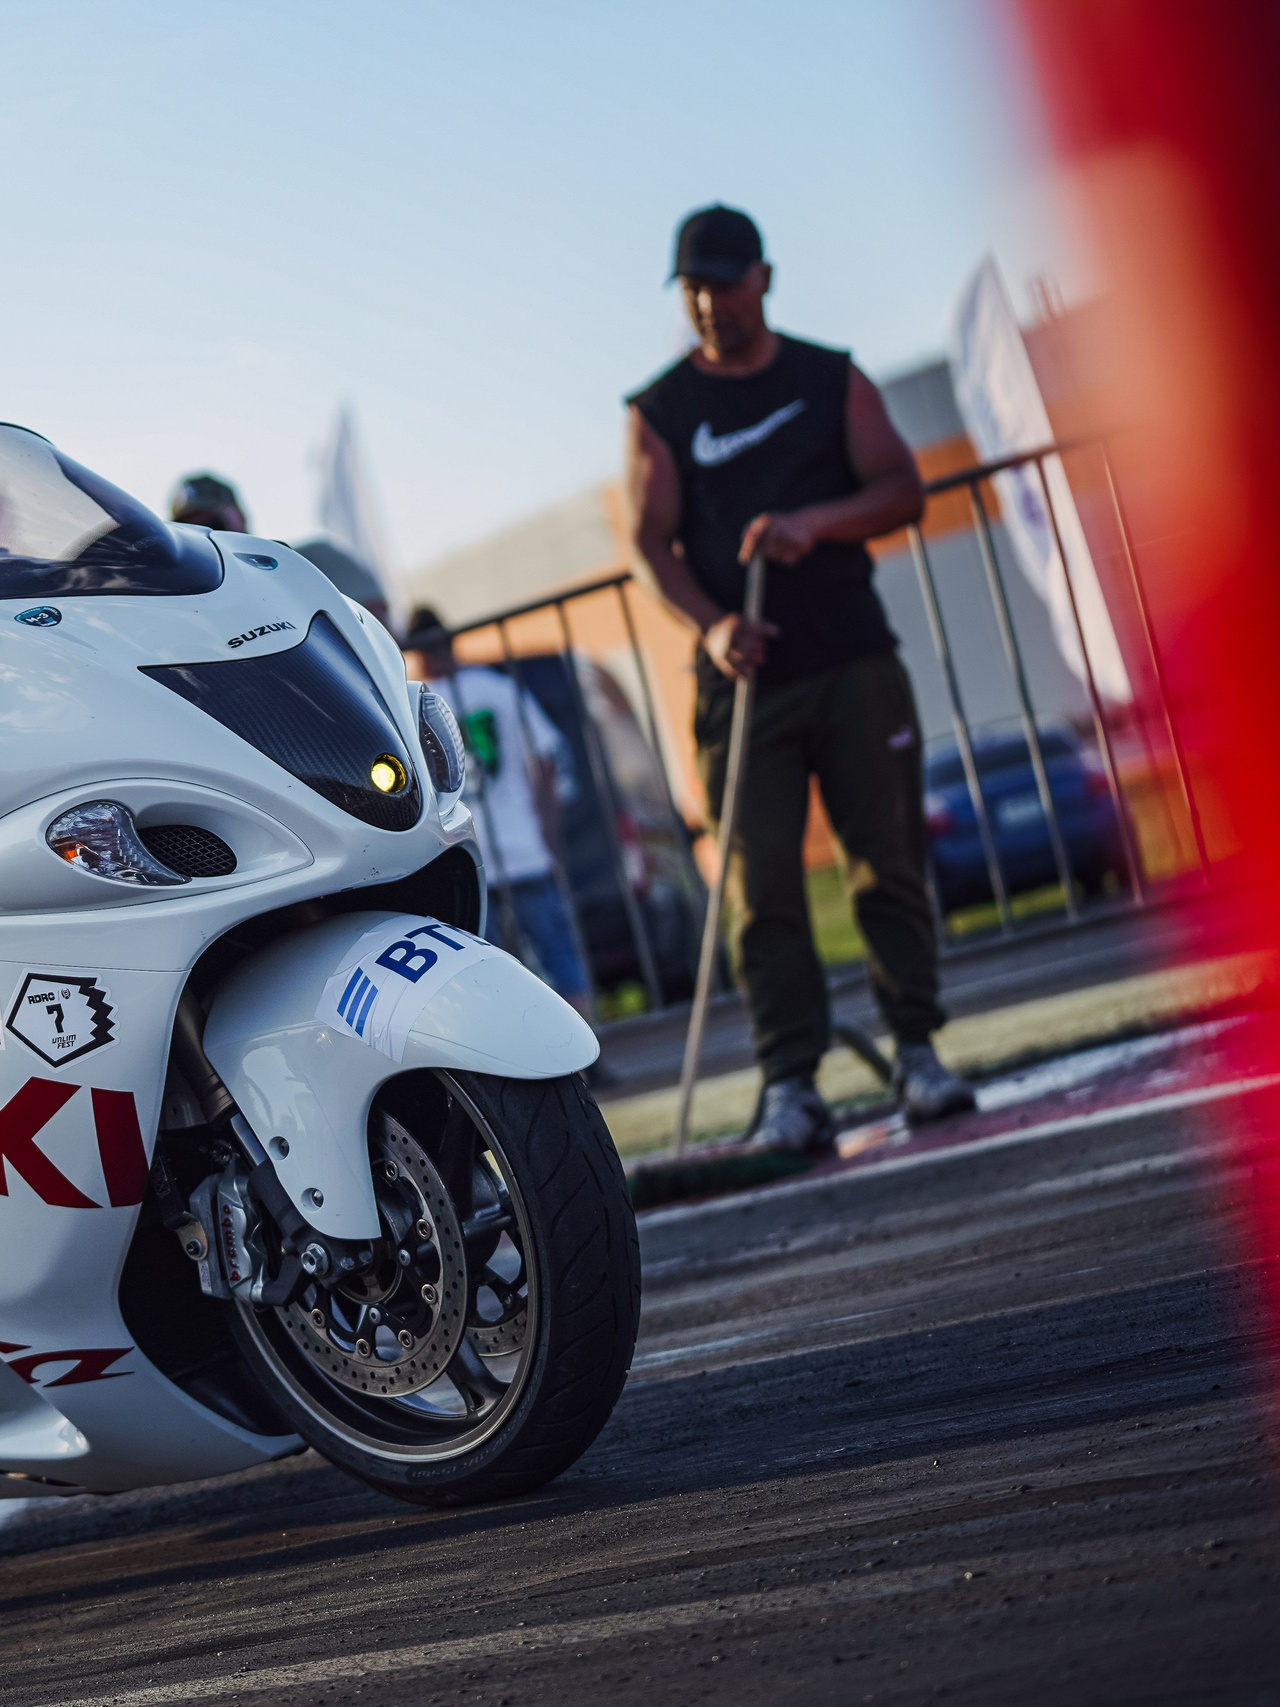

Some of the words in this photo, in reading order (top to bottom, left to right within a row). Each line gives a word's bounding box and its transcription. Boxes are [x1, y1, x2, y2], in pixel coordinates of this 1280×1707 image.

[227, 621, 297, 649] SUZUKI
[27, 992, 55, 1004] RDRC
[46, 1003, 64, 1033] 7
[57, 1041, 75, 1049] FEST
[222, 1204, 241, 1282] brembo
